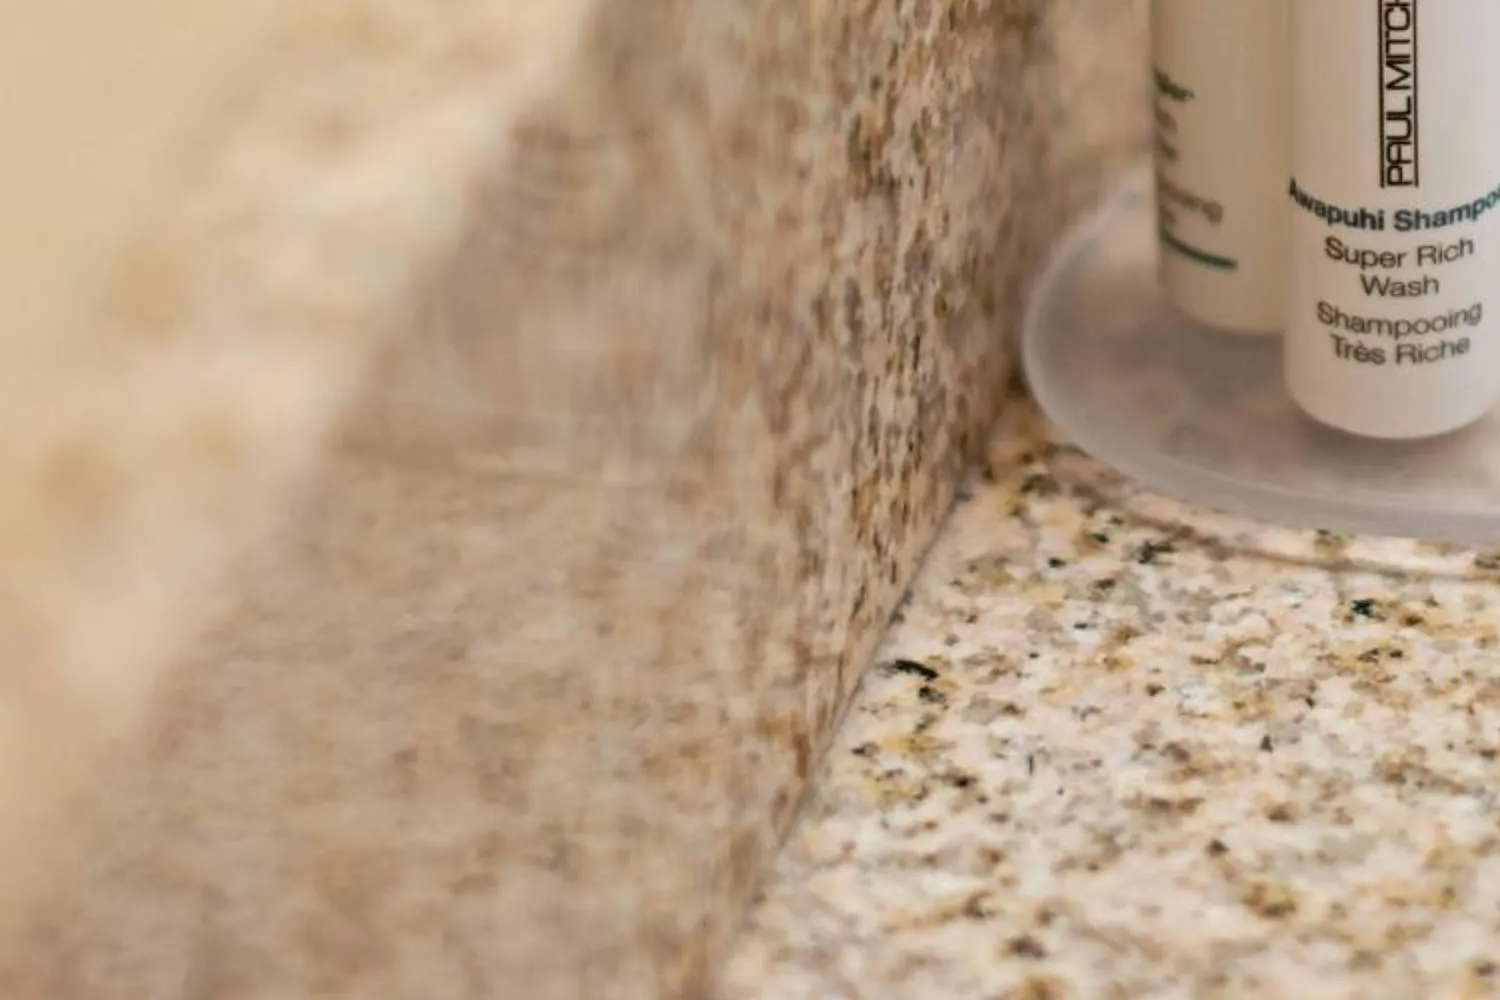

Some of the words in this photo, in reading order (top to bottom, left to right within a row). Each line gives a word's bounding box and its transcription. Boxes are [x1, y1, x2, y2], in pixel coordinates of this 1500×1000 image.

[1386, 97, 1412, 187] PAUL
[1288, 176, 1386, 231] Awapuhi
[1324, 236, 1409, 270] Super
[1416, 238, 1474, 266] Rich
[1360, 274, 1440, 297] Wash
[1316, 300, 1483, 340] Shampooing
[1330, 334, 1387, 365] Très
[1395, 337, 1472, 366] Riche
